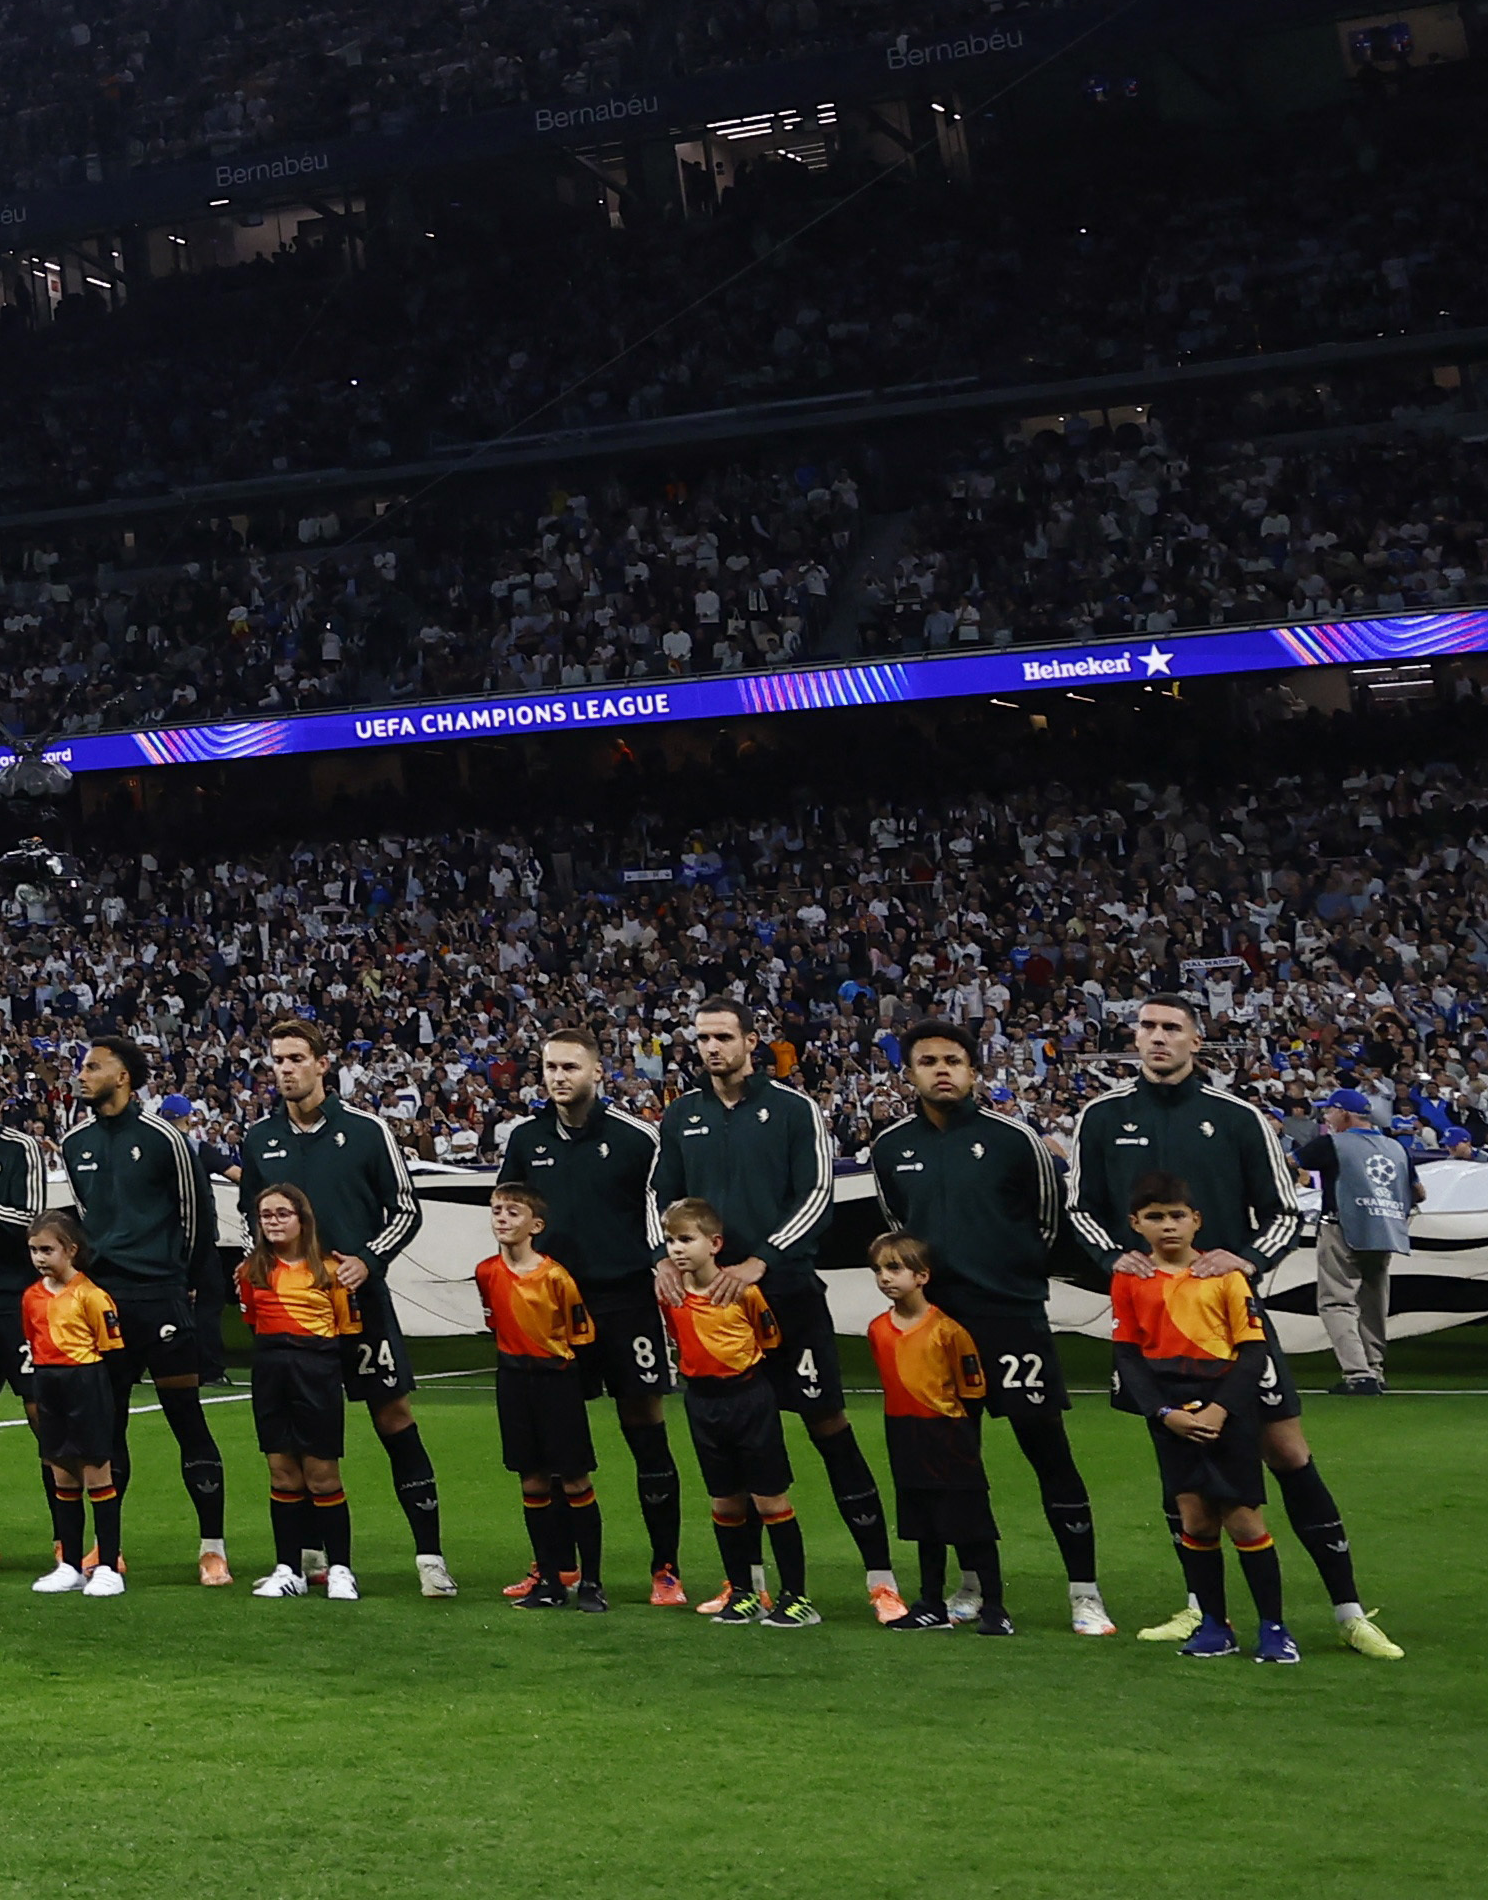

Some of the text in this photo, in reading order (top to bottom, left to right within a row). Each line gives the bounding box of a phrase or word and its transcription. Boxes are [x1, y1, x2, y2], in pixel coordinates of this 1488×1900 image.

[888, 28, 1025, 70] Bernabéu
[535, 93, 659, 131] Bernabéu
[216, 153, 329, 187] Bernabéu
[1022, 657, 1132, 681] Heineken
[355, 693, 670, 739] UEFA CHAMPIONS LEAGUE
[19, 1341, 35, 1374] 2
[357, 1340, 396, 1375] 24
[633, 1336, 656, 1369] 8
[796, 1348, 819, 1383] 4
[999, 1353, 1045, 1388] 22
